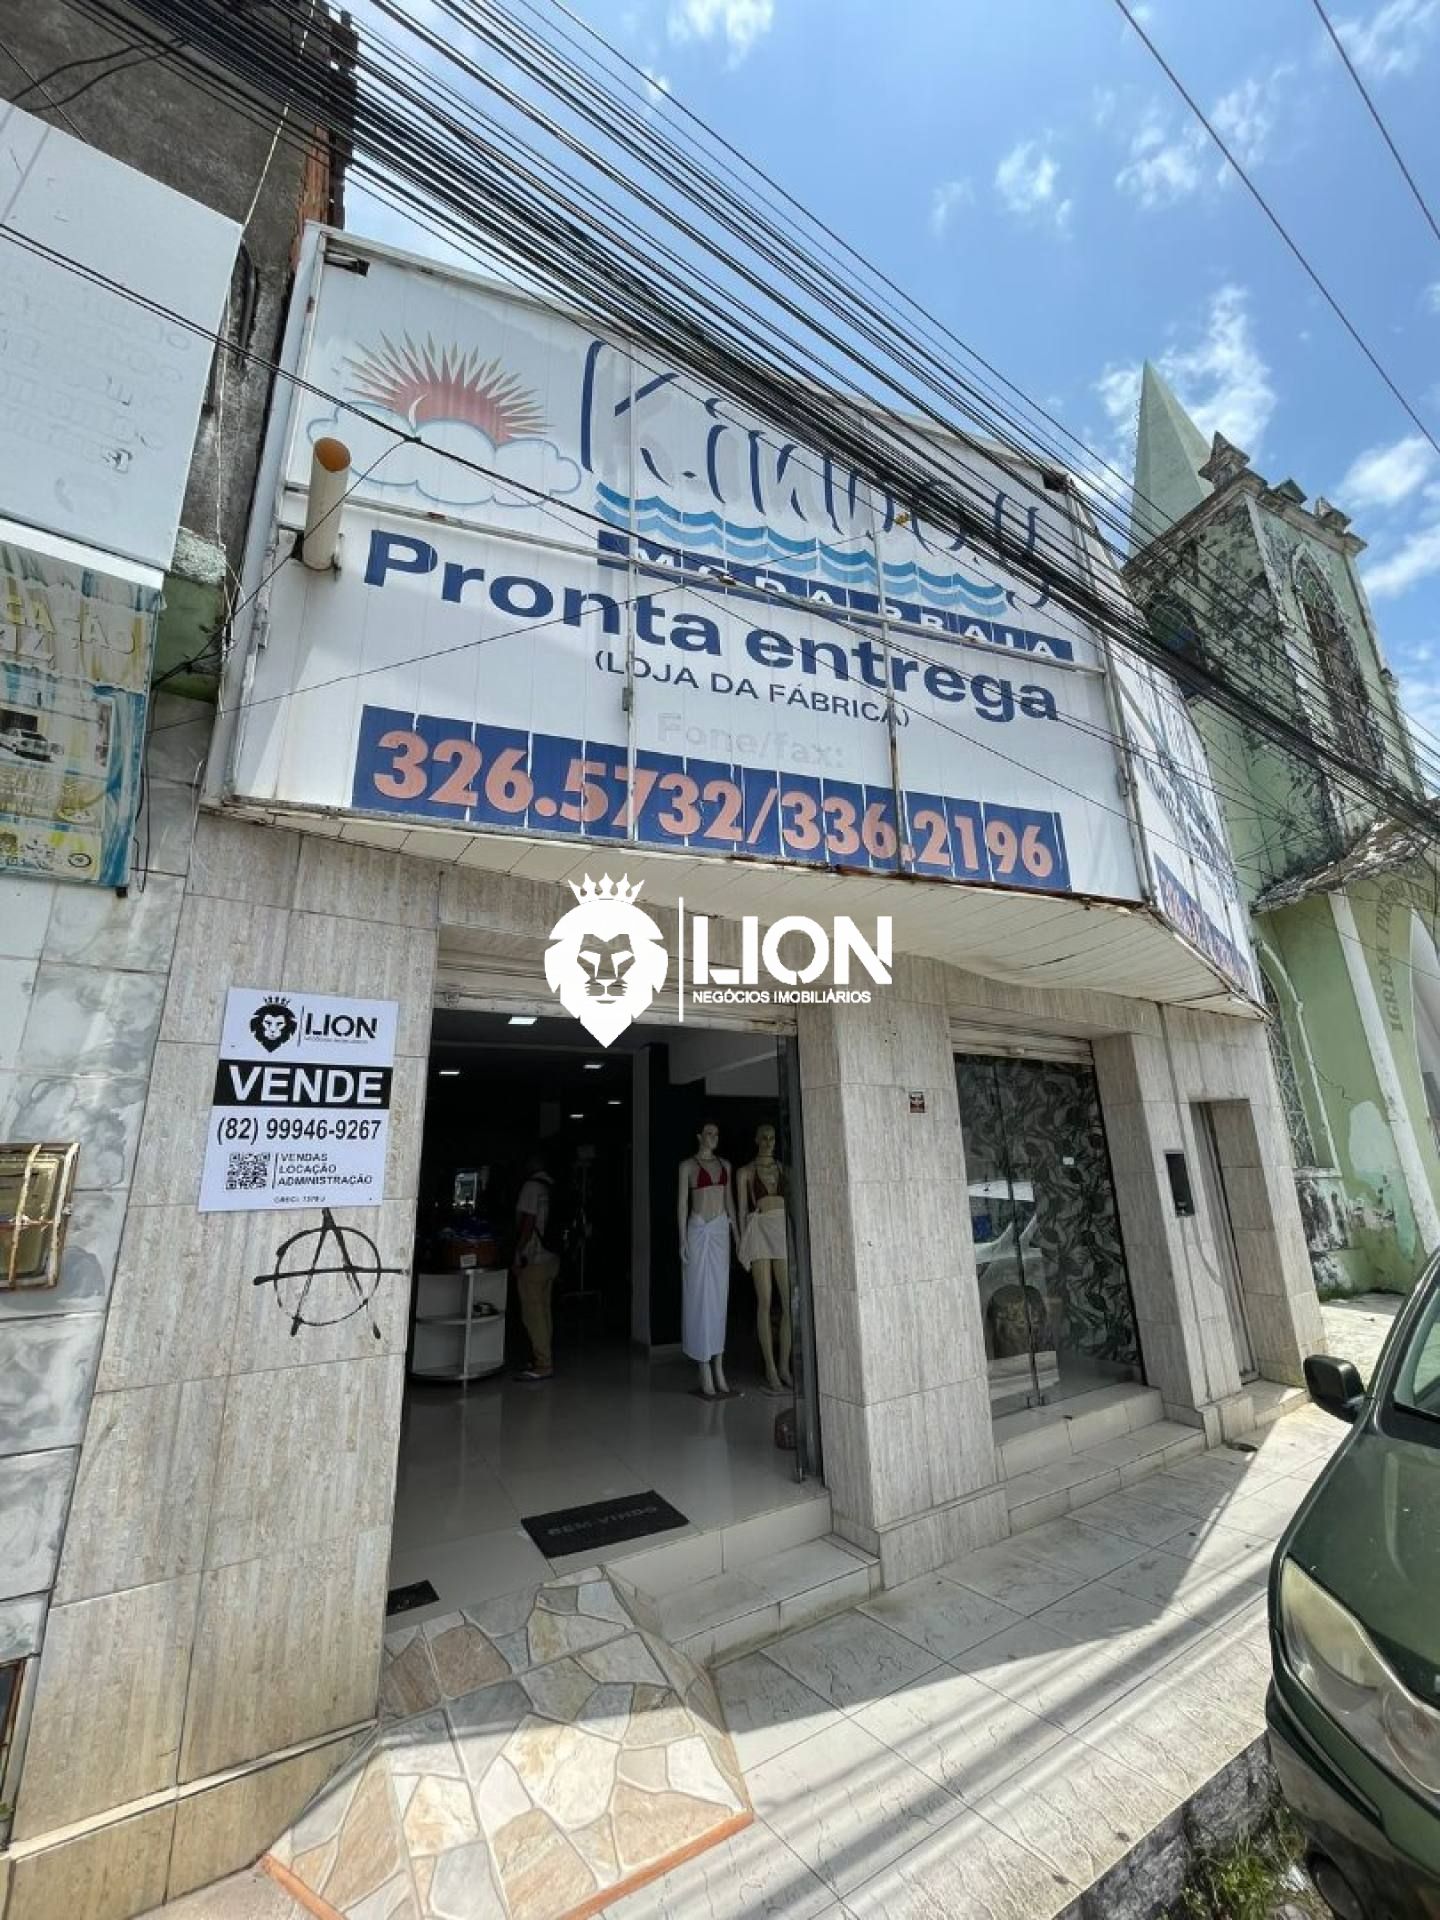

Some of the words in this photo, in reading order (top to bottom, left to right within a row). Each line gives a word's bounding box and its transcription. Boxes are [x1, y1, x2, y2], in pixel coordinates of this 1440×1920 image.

[363, 529, 721, 656] Pronta
[745, 626, 1058, 723] entrega
[595, 649, 700, 689] (LOJA
[711, 672, 759, 700] DA
[768, 681, 910, 728] FÁBRICA)
[372, 730, 1054, 879] 326.5732/336.2196
[304, 1012, 378, 1039] LION
[228, 1064, 383, 1105] VENDE
[217, 1117, 259, 1146] (82)
[266, 1118, 382, 1141] 99946-9267
[278, 1163, 337, 1175] LOCAÇÃO
[279, 1153, 328, 1162] VENDAS
[277, 1174, 373, 1186] ADMINISTRAÇÃO
